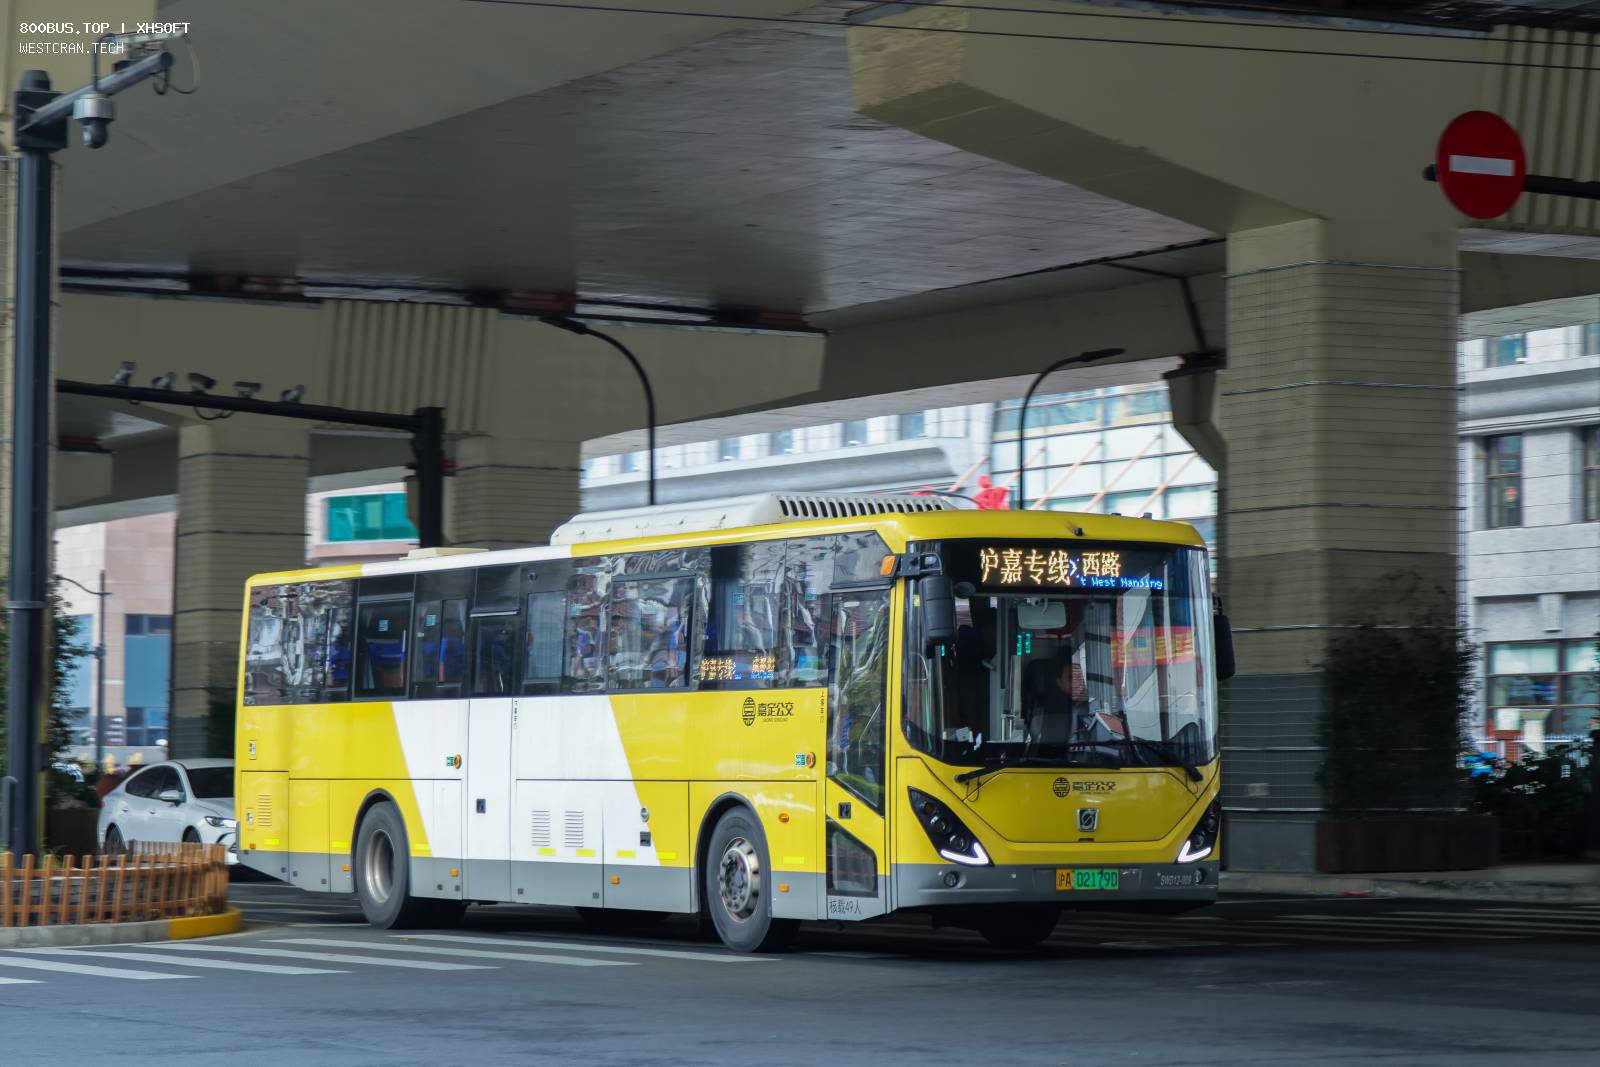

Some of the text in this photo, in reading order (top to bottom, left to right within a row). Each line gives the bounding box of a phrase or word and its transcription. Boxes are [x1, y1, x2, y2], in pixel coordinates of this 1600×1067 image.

[979, 548, 1071, 586] 沪嘉专线
[757, 702, 795, 717] 嘉定公交
